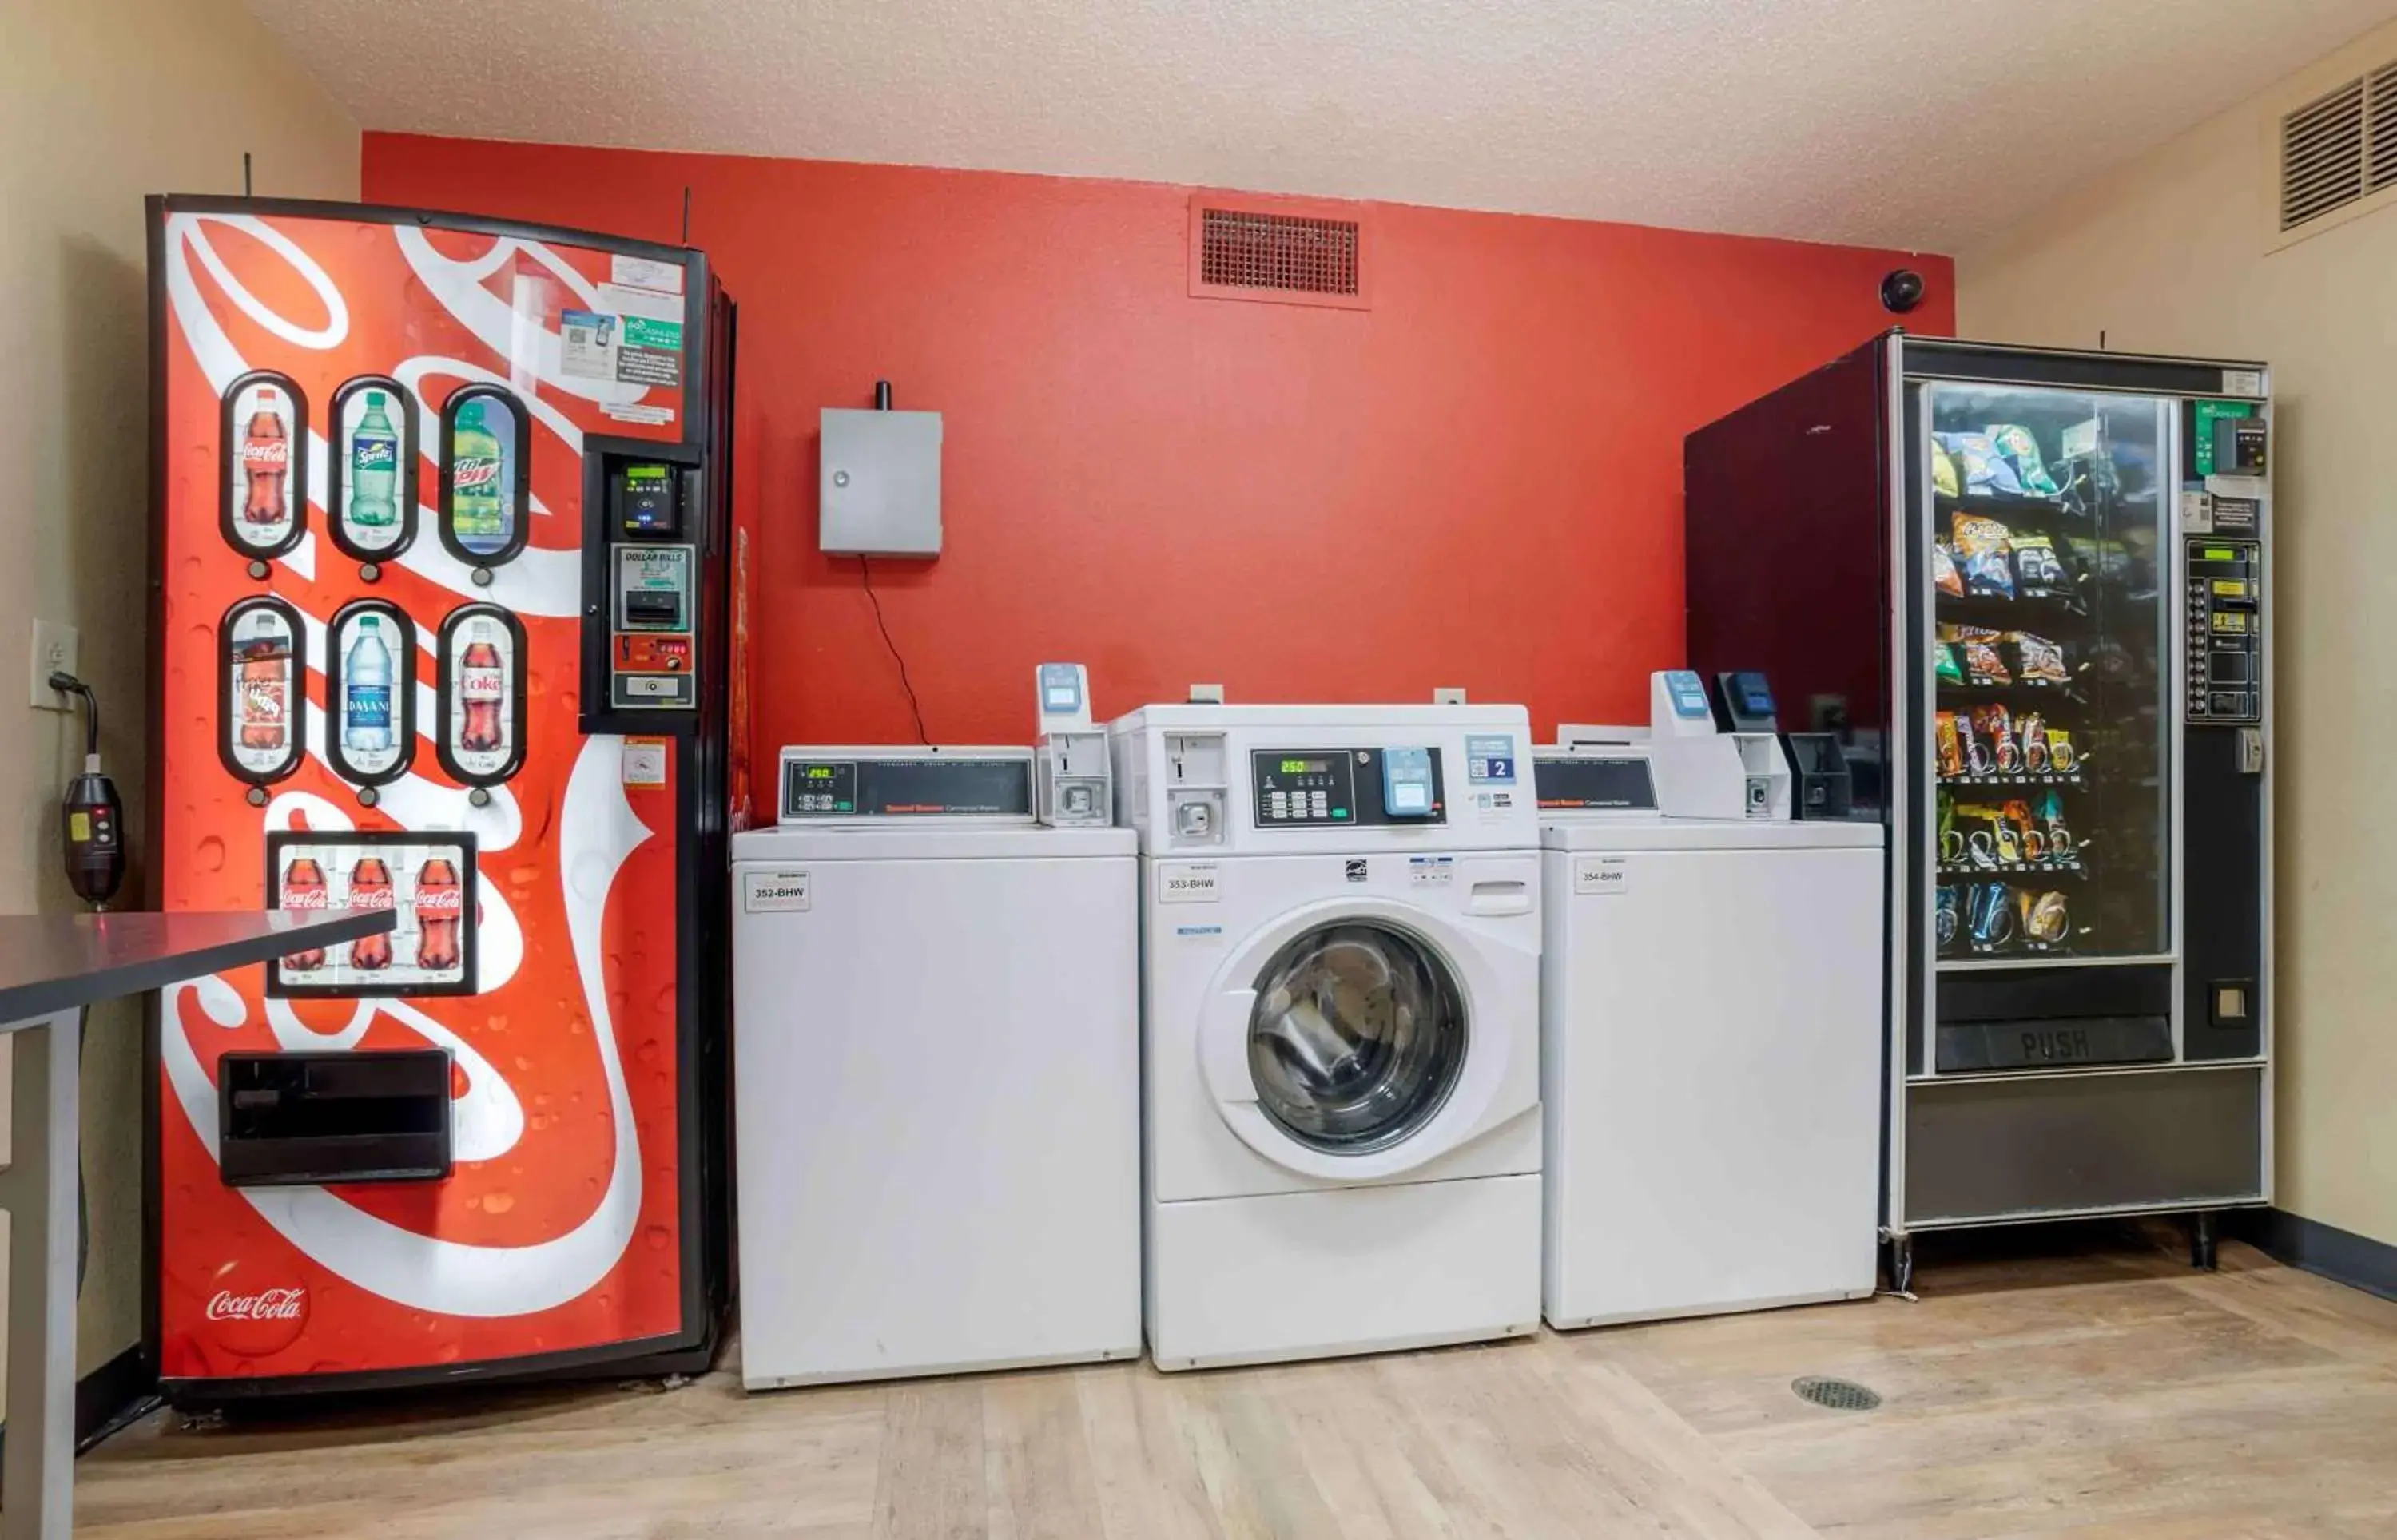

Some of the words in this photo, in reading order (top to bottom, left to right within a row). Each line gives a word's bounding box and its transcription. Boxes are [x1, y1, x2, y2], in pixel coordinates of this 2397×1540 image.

[359, 449, 393, 466] Sprite
[349, 698, 390, 714] DASANI
[1495, 761, 1506, 776] 2
[415, 889, 459, 908] Coca-Cola
[755, 888, 805, 899] 352-BHW
[2021, 1029, 2089, 1059] PUSH
[206, 1288, 306, 1321] Coca-Cola
